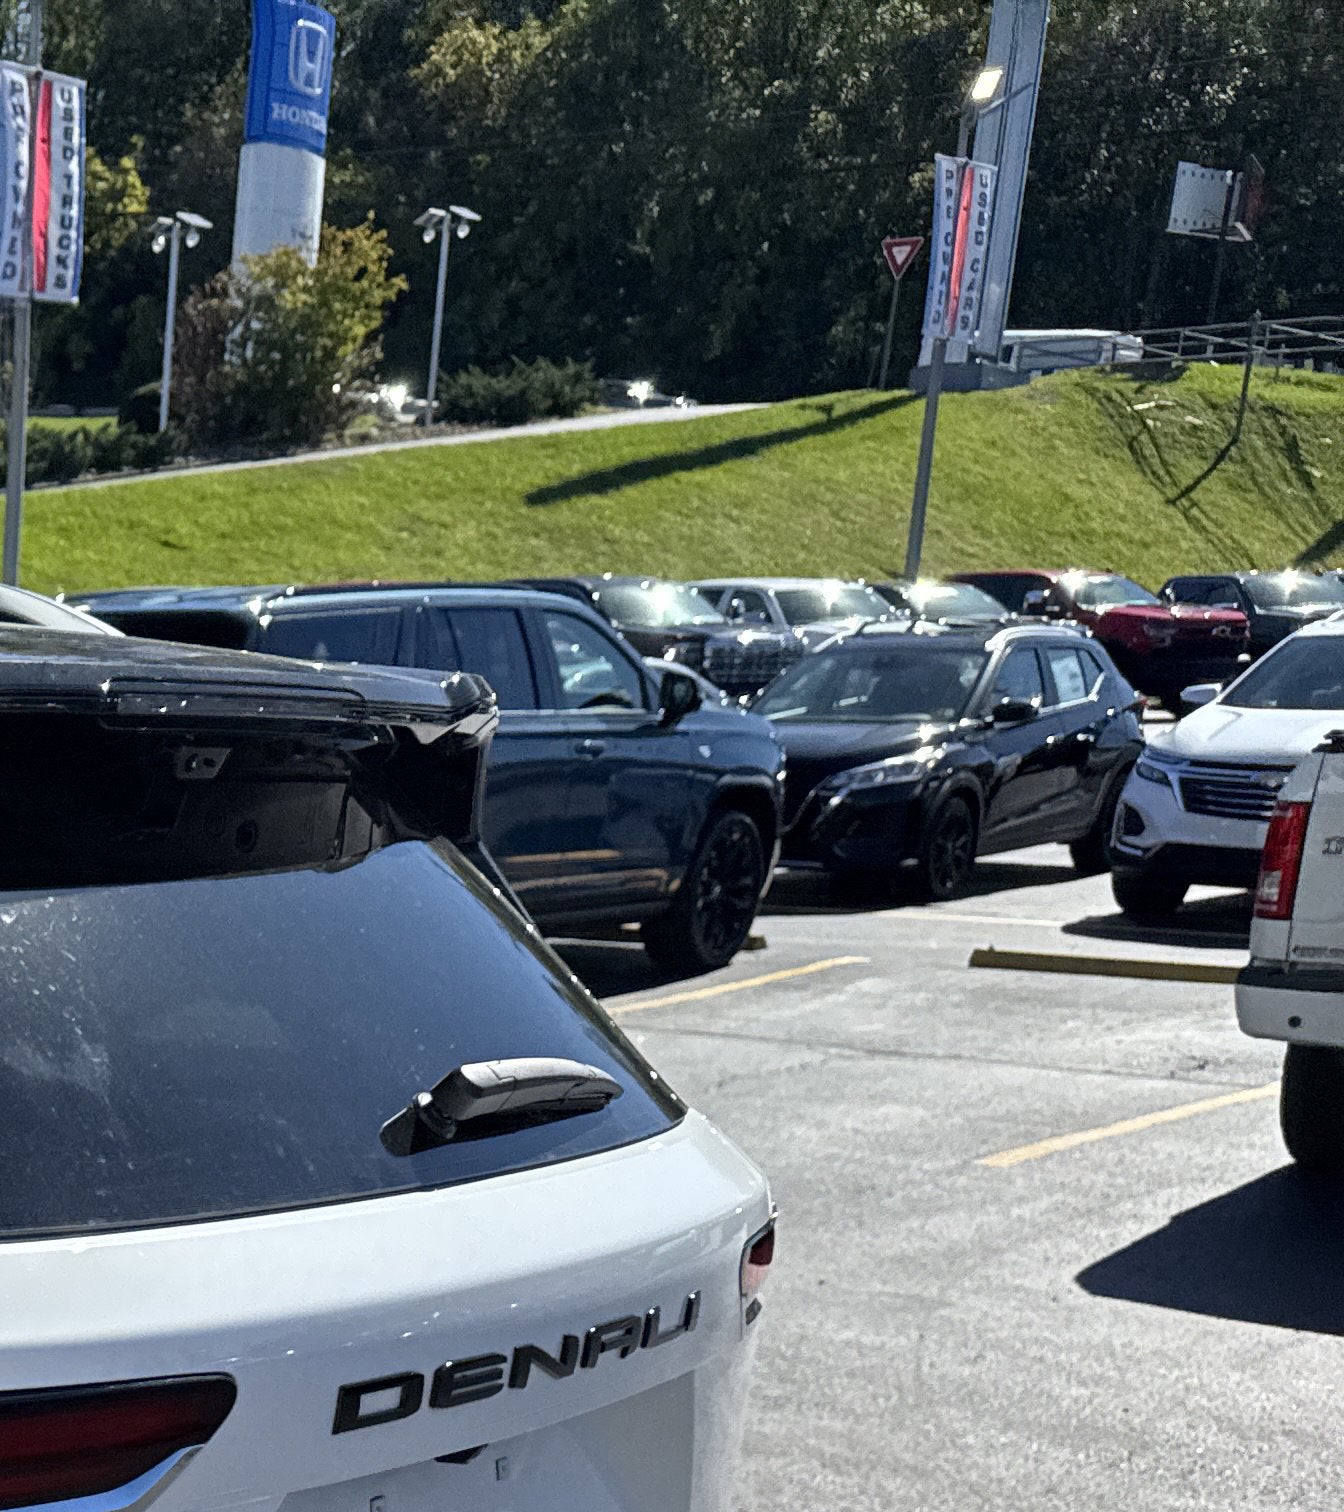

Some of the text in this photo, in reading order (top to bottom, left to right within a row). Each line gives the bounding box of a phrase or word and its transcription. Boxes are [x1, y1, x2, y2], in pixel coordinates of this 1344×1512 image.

[52, 86, 75, 291] USED TRUCKS
[959, 173, 989, 332] USED CARS
[330, 1289, 703, 1436] DENALI
